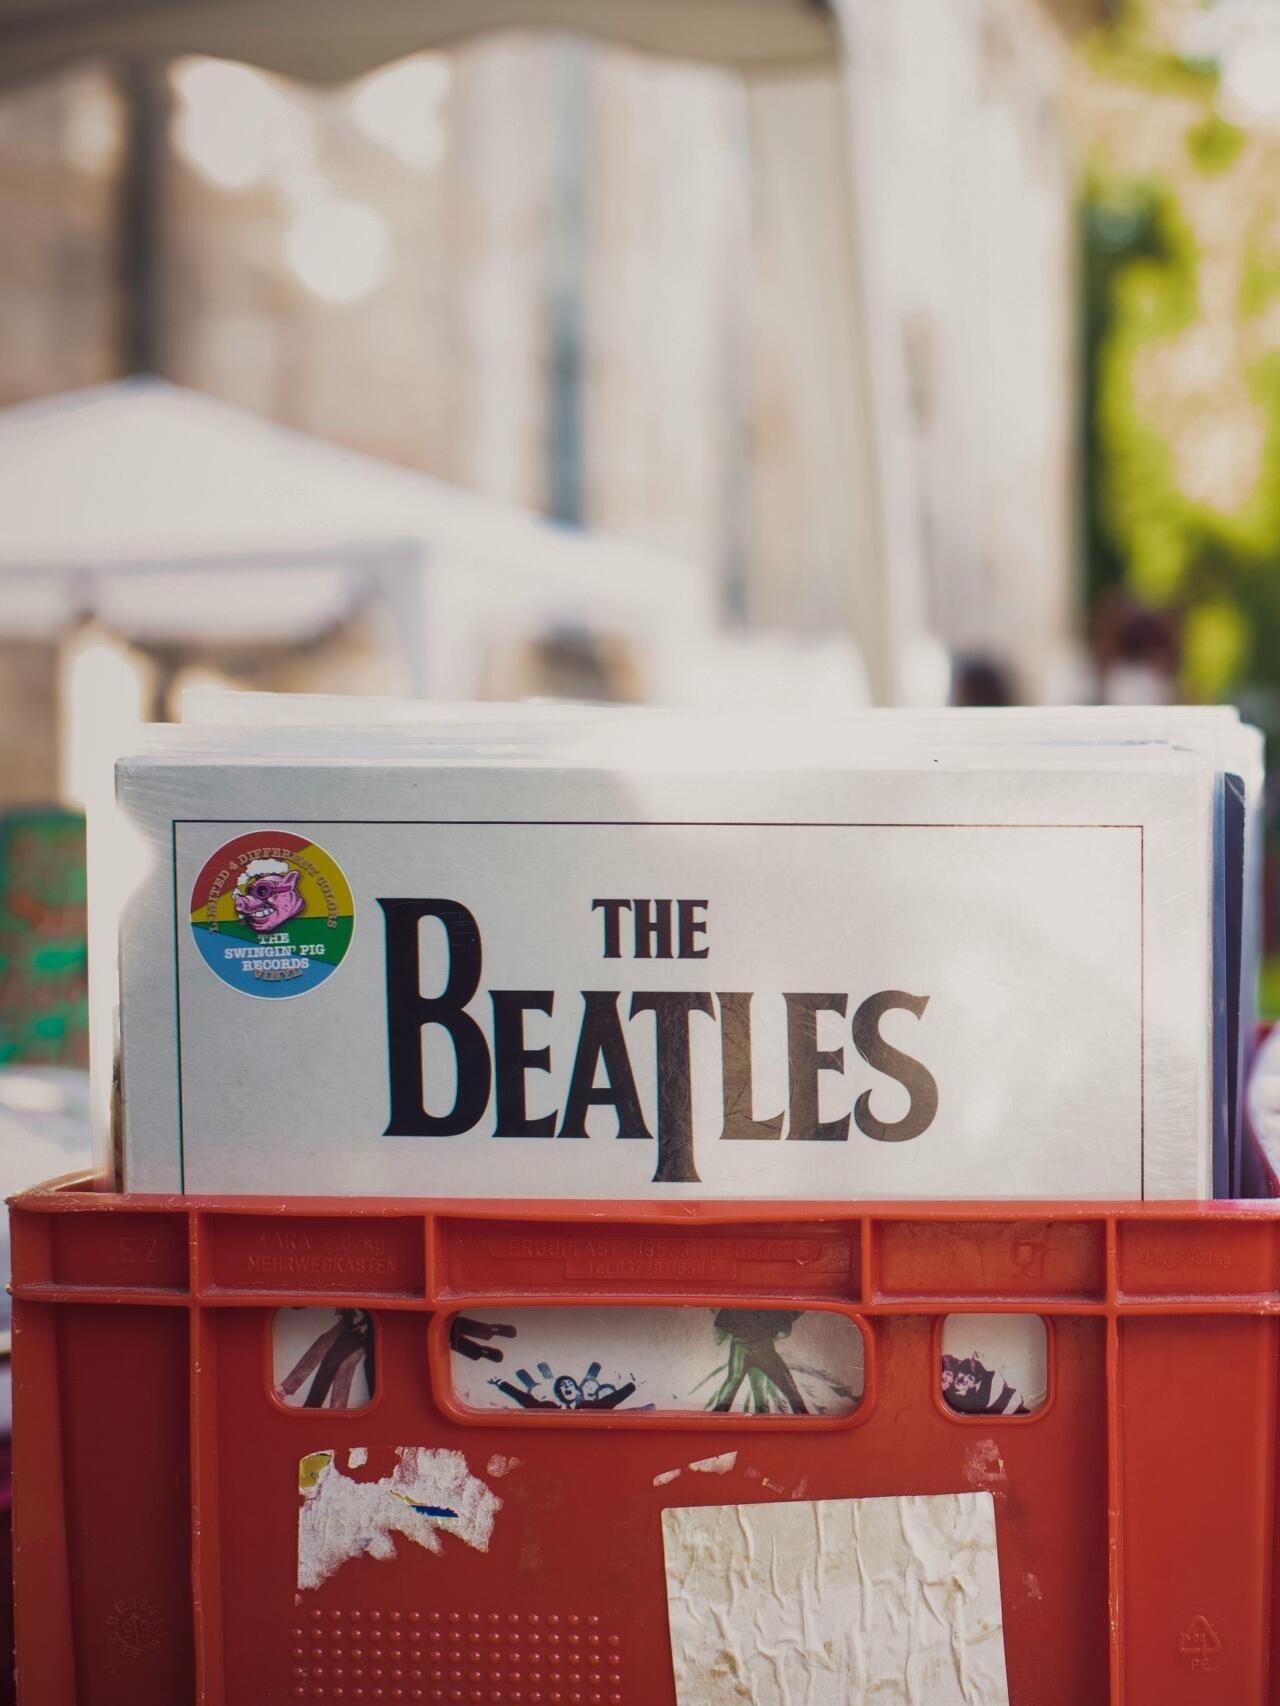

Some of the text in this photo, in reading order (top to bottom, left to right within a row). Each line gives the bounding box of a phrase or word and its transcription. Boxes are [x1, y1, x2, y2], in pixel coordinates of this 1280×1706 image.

[237, 847, 319, 877] DIFFERENT
[592, 898, 710, 959] THE
[258, 932, 290, 945] THE
[224, 944, 326, 960] SWINGIN' PIG
[241, 958, 310, 972] RECORDS
[376, 897, 939, 1183] BEATLES
[246, 1255, 399, 1274] MEHRWEGKASTEN
